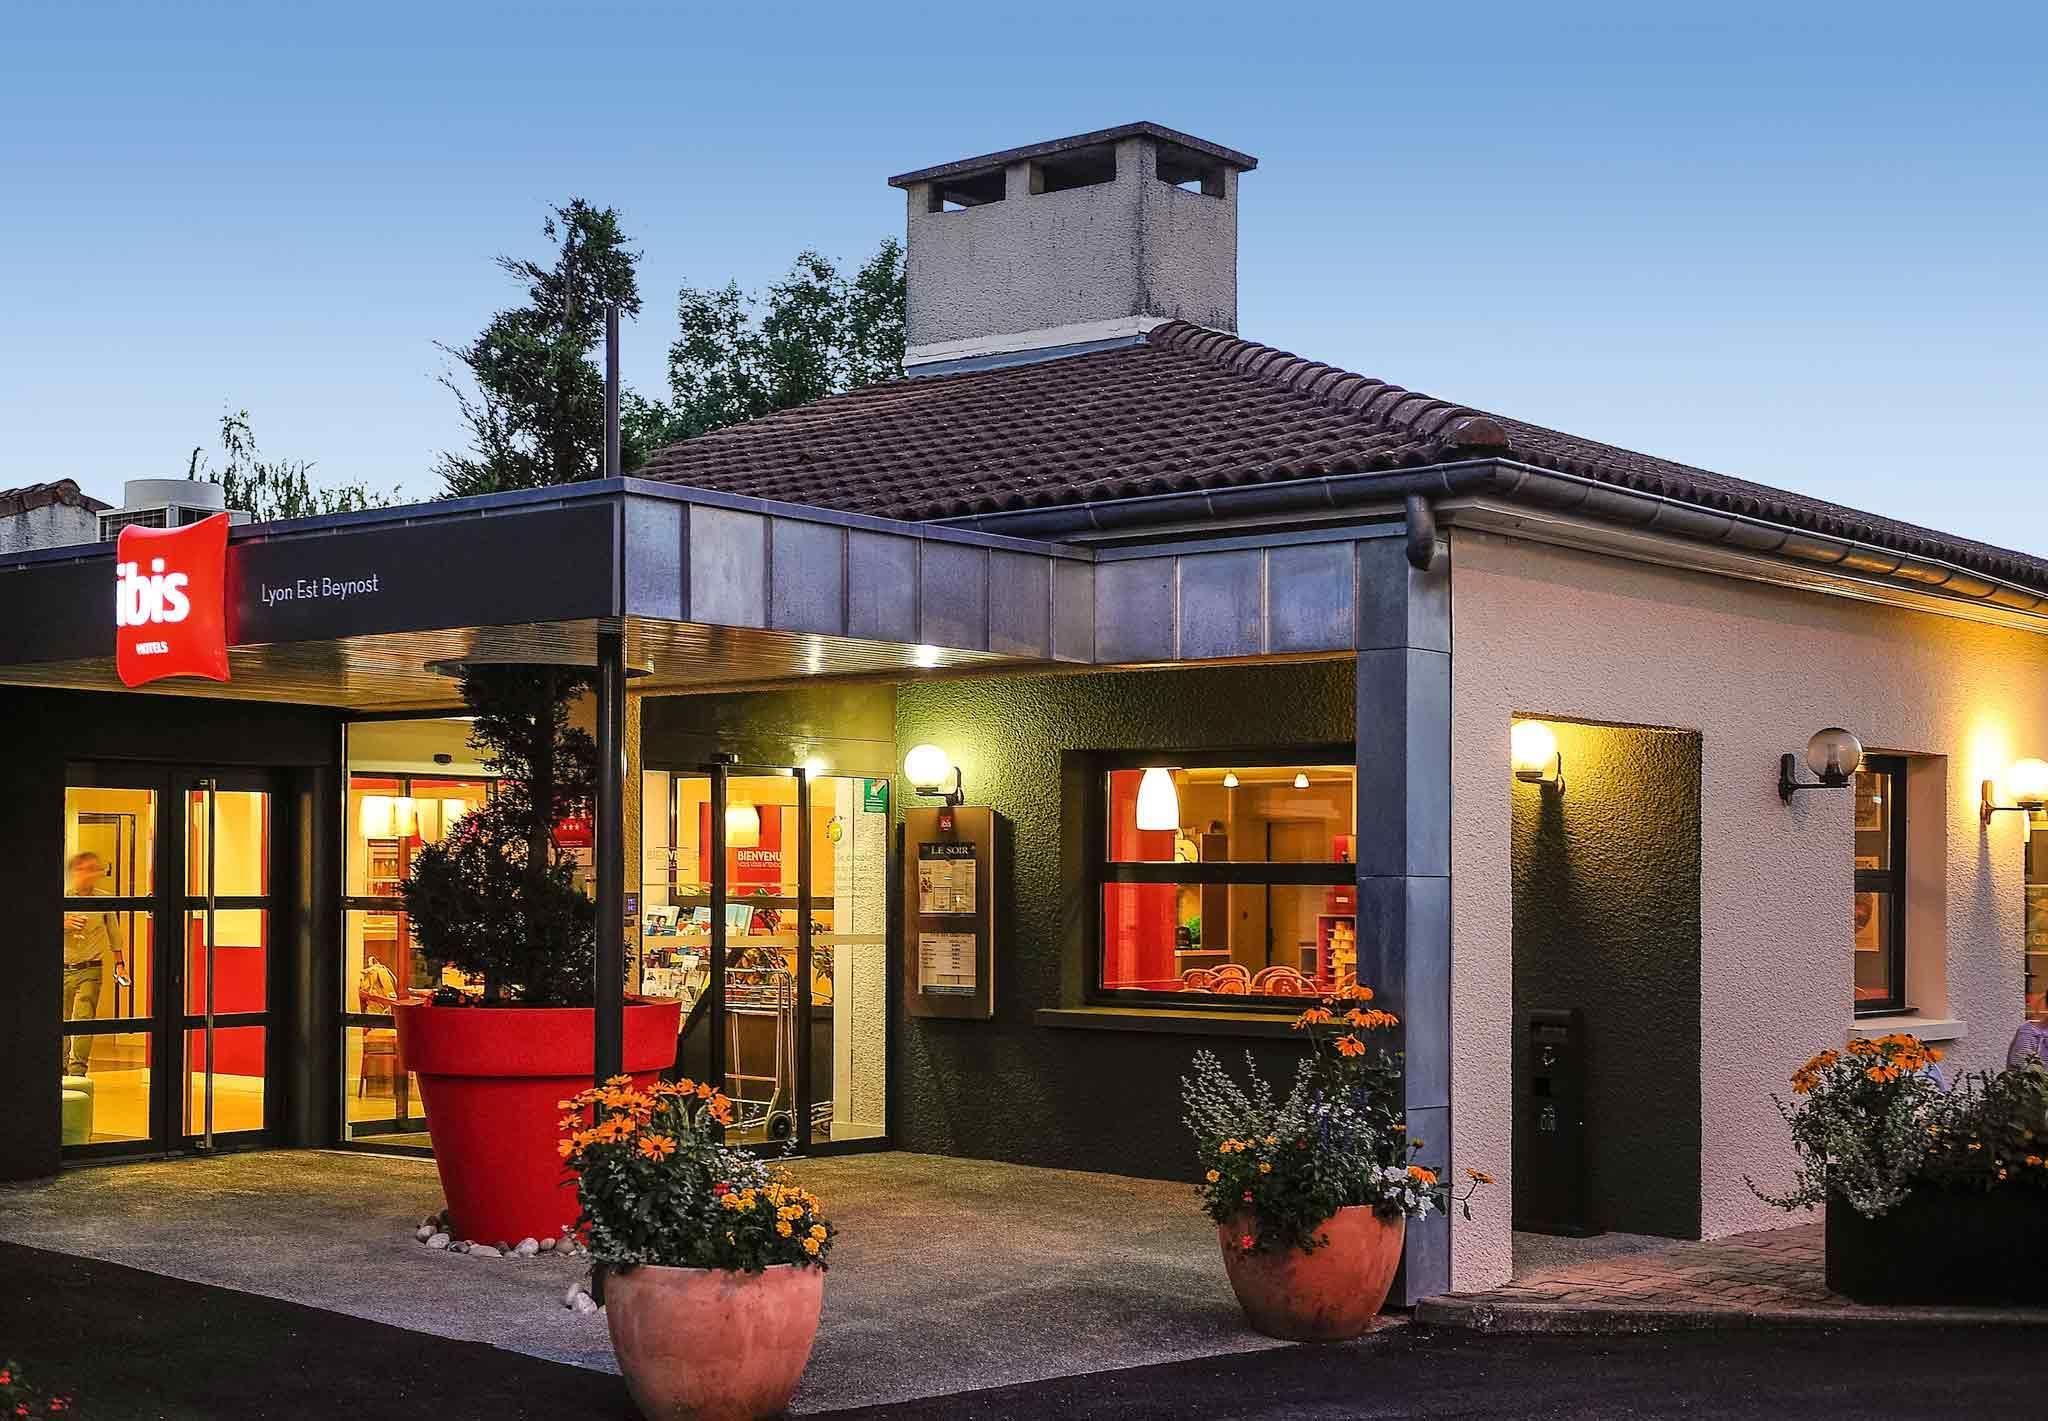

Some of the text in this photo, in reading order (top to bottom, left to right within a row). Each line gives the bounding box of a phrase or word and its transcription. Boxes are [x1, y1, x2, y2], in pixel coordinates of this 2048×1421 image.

[116, 558, 190, 627] ibis
[261, 574, 379, 607] Lyon Est Beynost
[931, 846, 969, 855] LE SOIR
